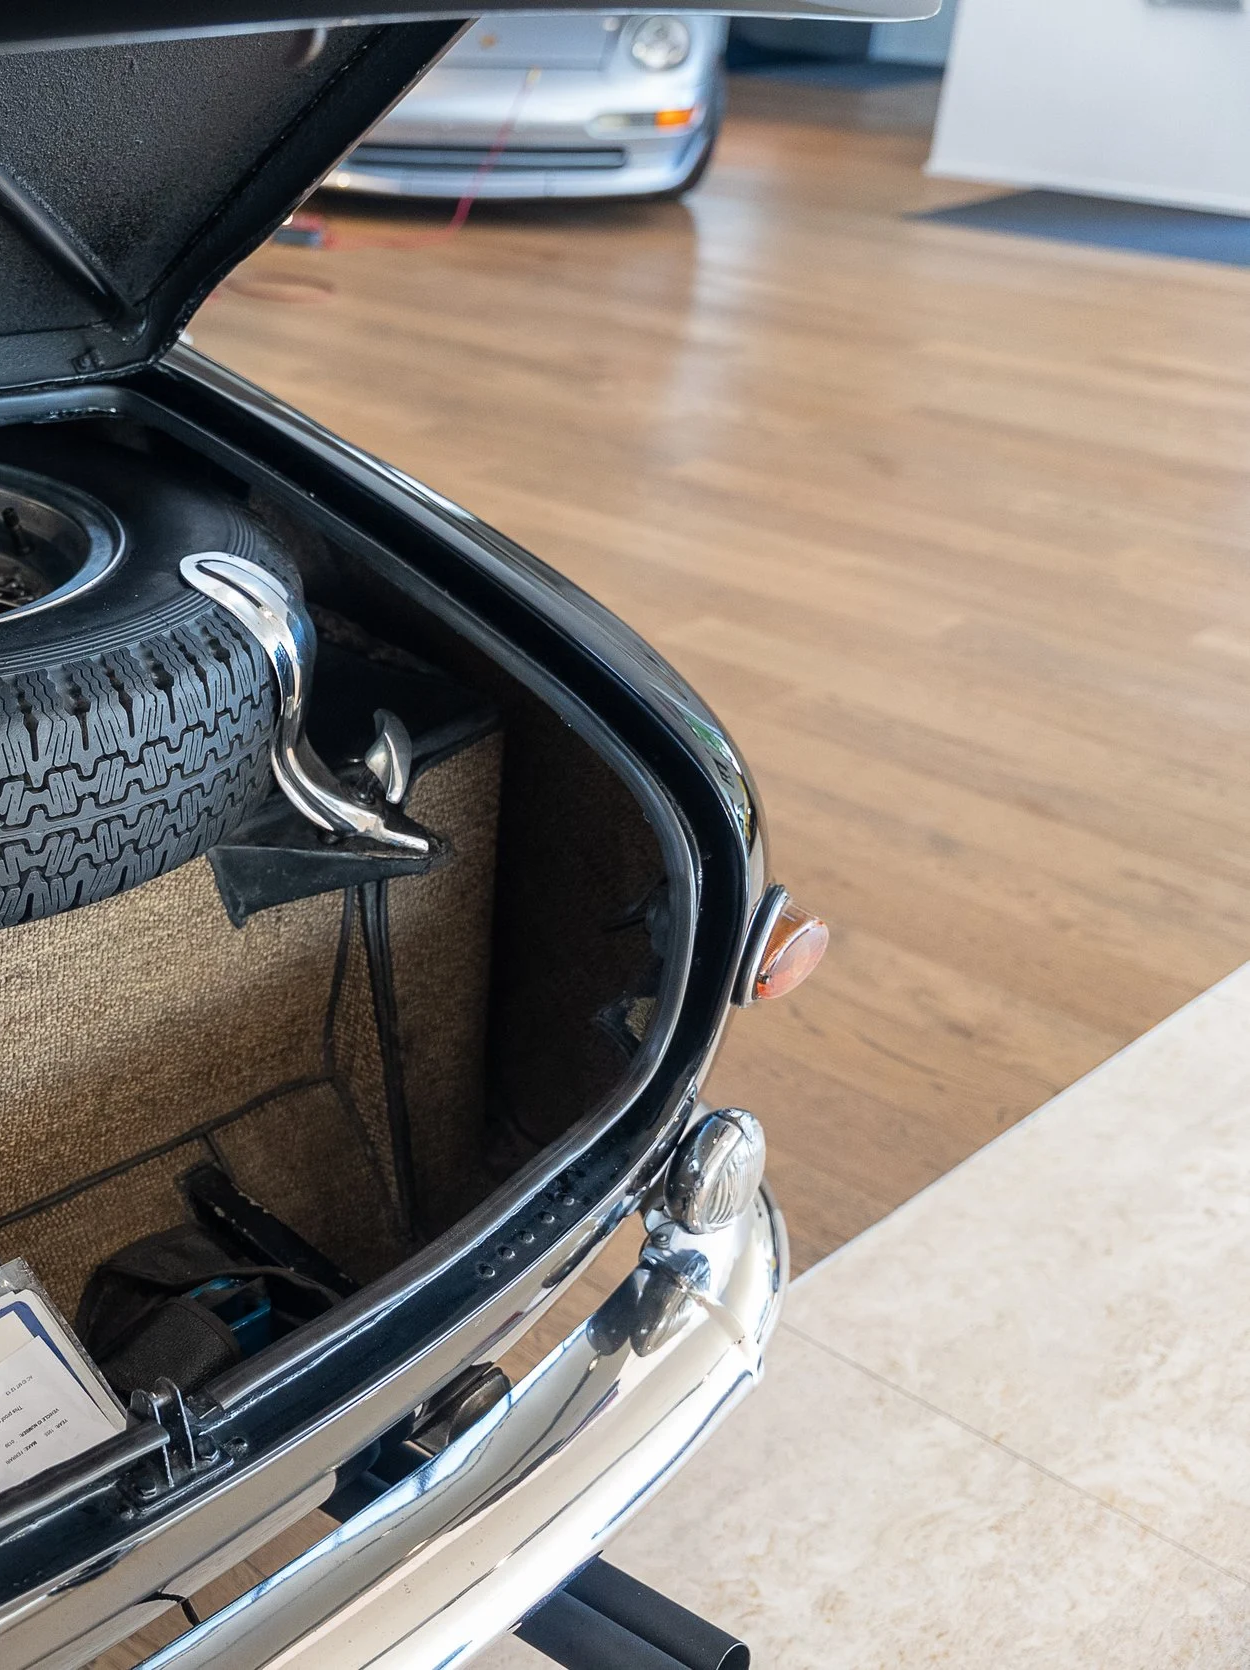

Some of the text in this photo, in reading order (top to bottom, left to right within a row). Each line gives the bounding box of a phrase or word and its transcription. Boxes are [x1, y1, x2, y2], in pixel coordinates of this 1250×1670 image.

[42, 1408, 59, 1421] VEHICLE
[18, 1423, 37, 1437] NUMBER:
[4, 1450, 23, 1464] FERRARI
